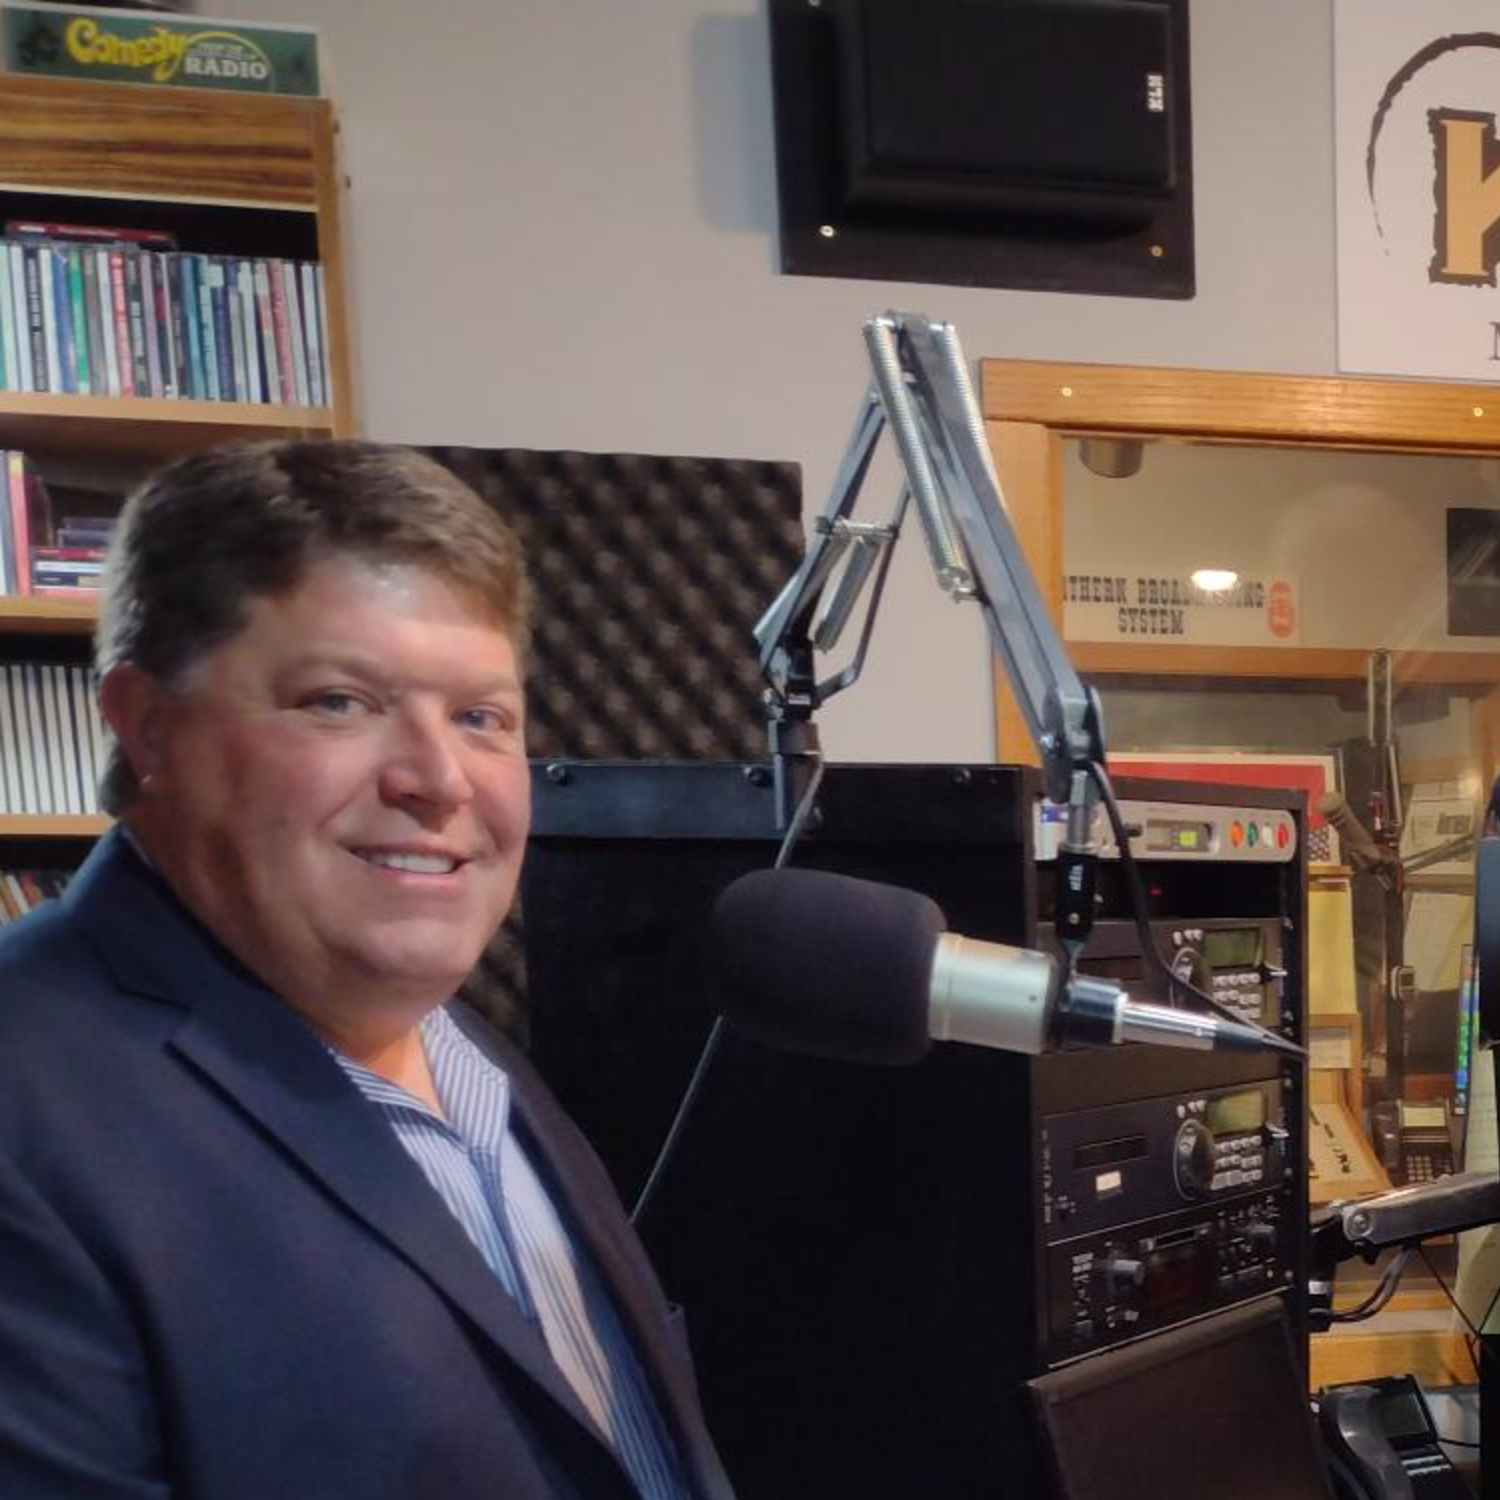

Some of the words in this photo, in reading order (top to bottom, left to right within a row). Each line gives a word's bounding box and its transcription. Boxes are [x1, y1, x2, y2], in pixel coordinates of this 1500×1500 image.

[66, 17, 188, 82] Comedy
[184, 56, 268, 80] RADIO
[1062, 575, 1128, 604] THERN
[1118, 607, 1185, 635] SYSTEM
